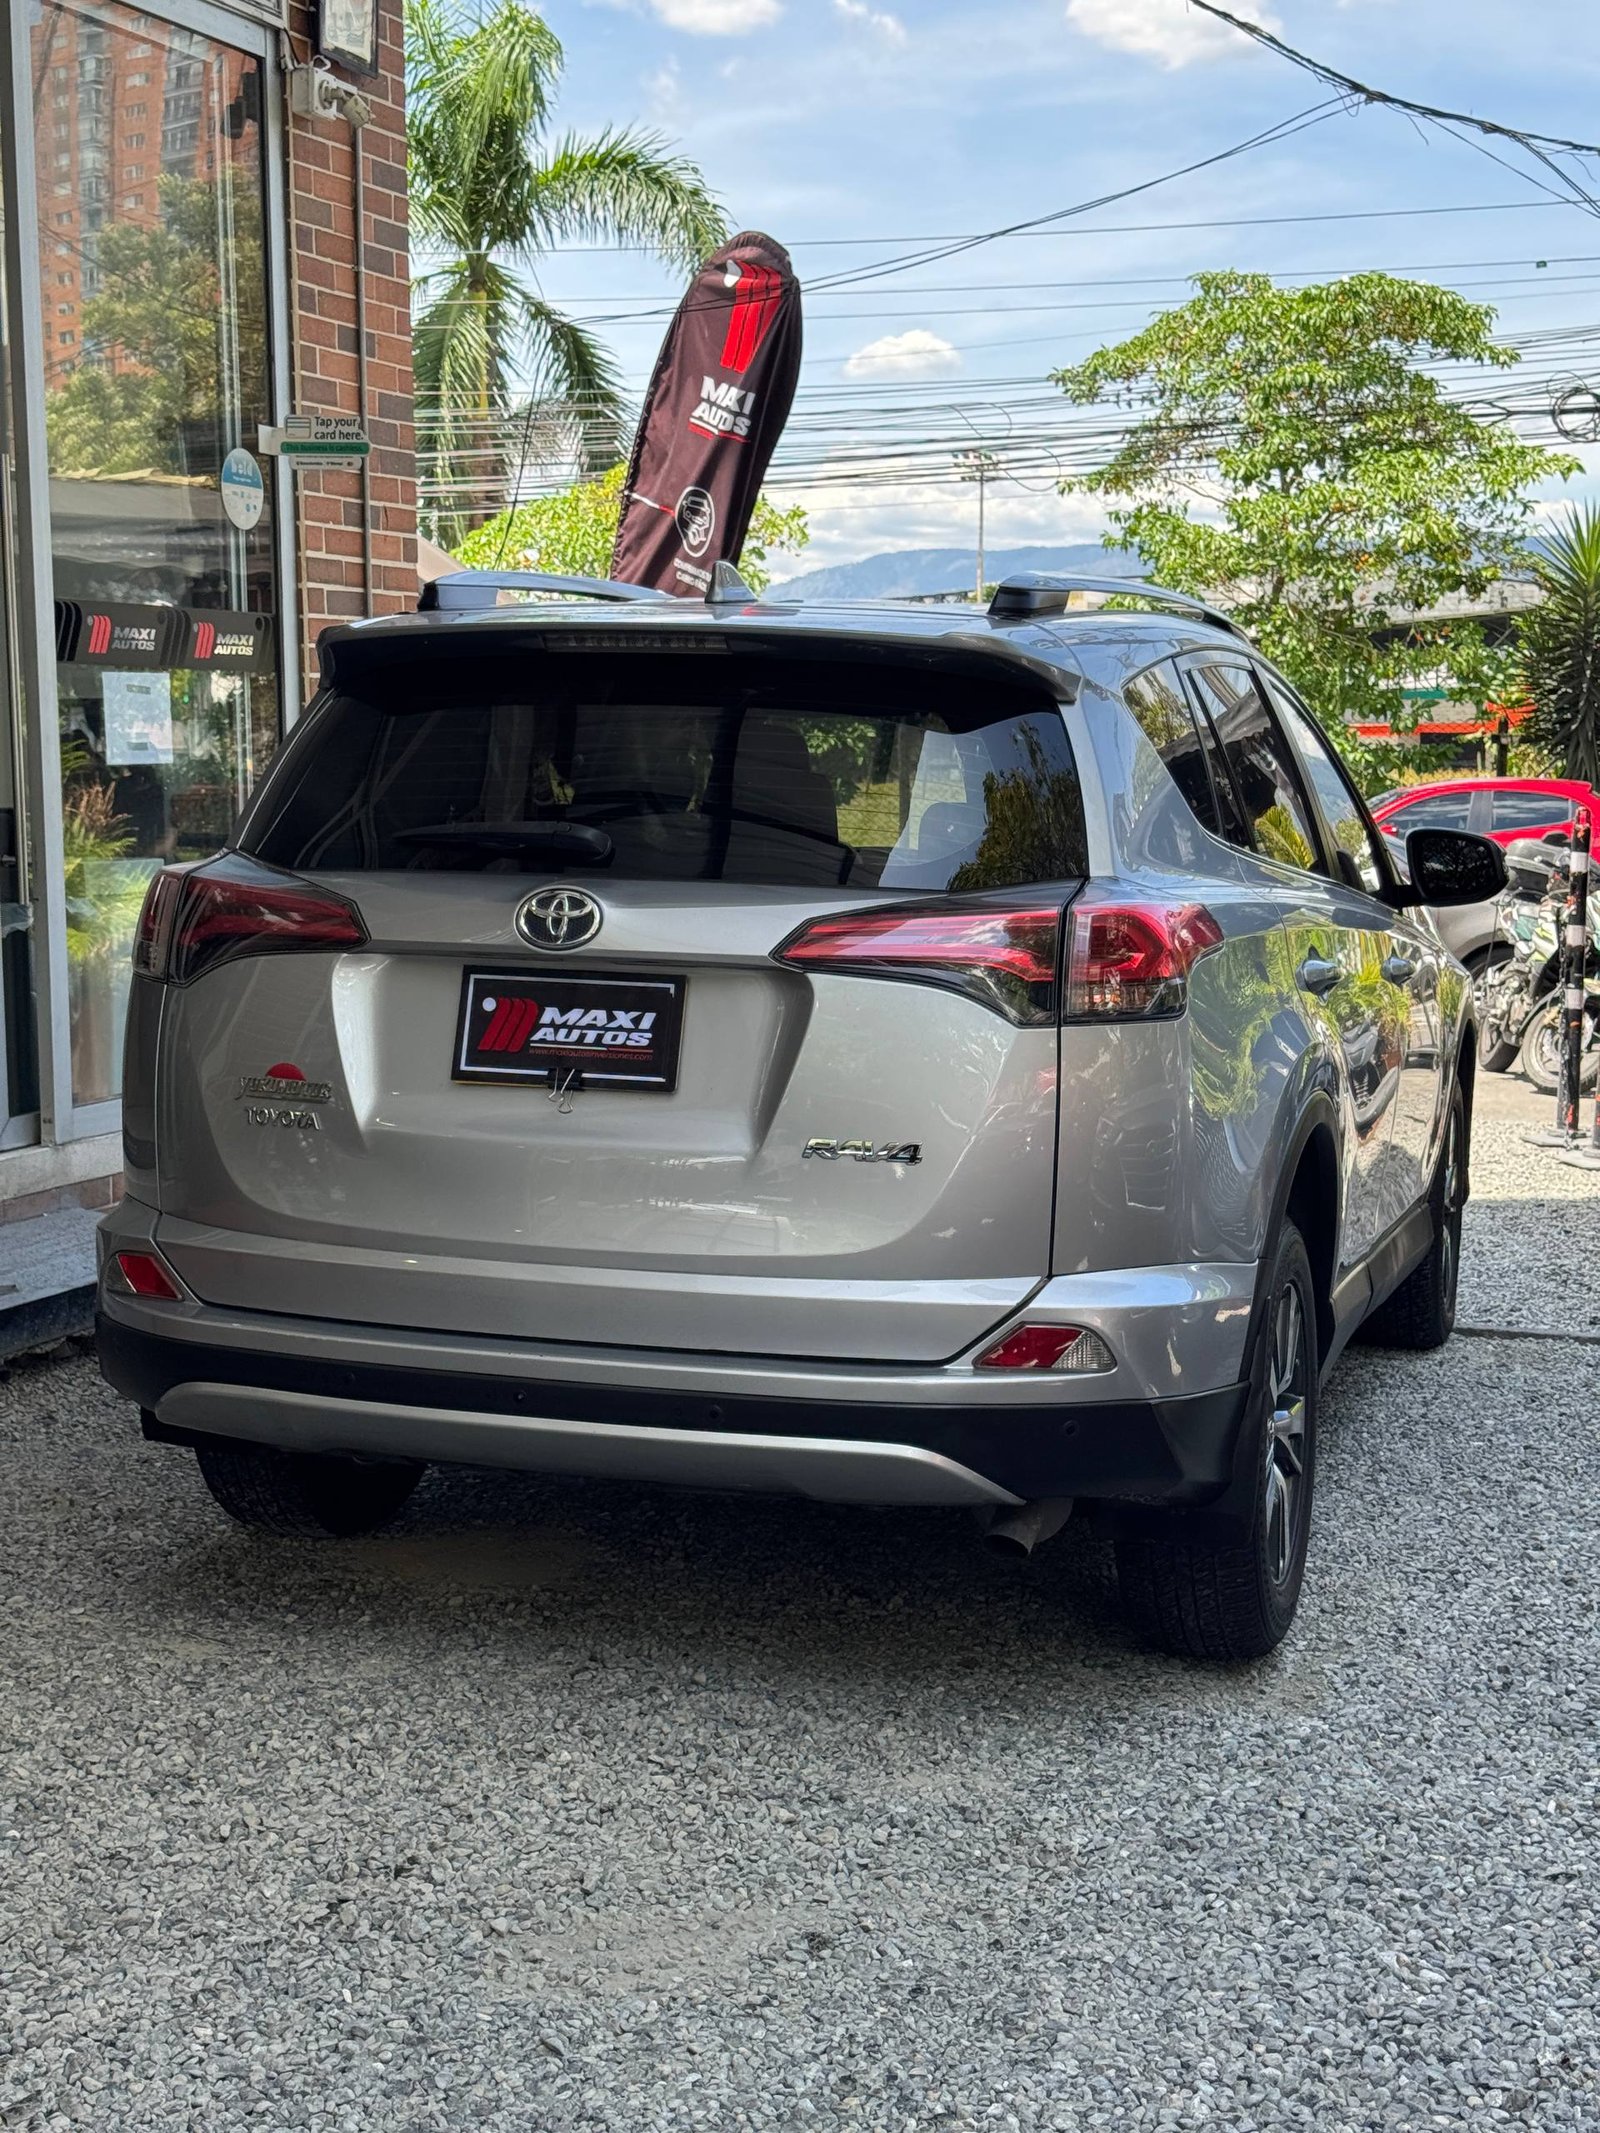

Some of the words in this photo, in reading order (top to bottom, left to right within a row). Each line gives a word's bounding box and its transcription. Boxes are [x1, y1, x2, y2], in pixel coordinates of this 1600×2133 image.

[314, 416, 332, 428] Tap
[333, 417, 358, 428] your
[691, 401, 751, 436] AUOS
[314, 430, 337, 440] card
[338, 430, 364, 440] here.
[113, 626, 157, 640] MAXI
[216, 633, 254, 645] MAXI
[111, 640, 155, 651] AUTOS
[214, 645, 254, 656] AUTOS
[539, 1006, 657, 1030] MAXI
[530, 1027, 653, 1046] AUTOS
[246, 1105, 321, 1131] TOYOTA
[801, 1137, 923, 1166] RAV4
